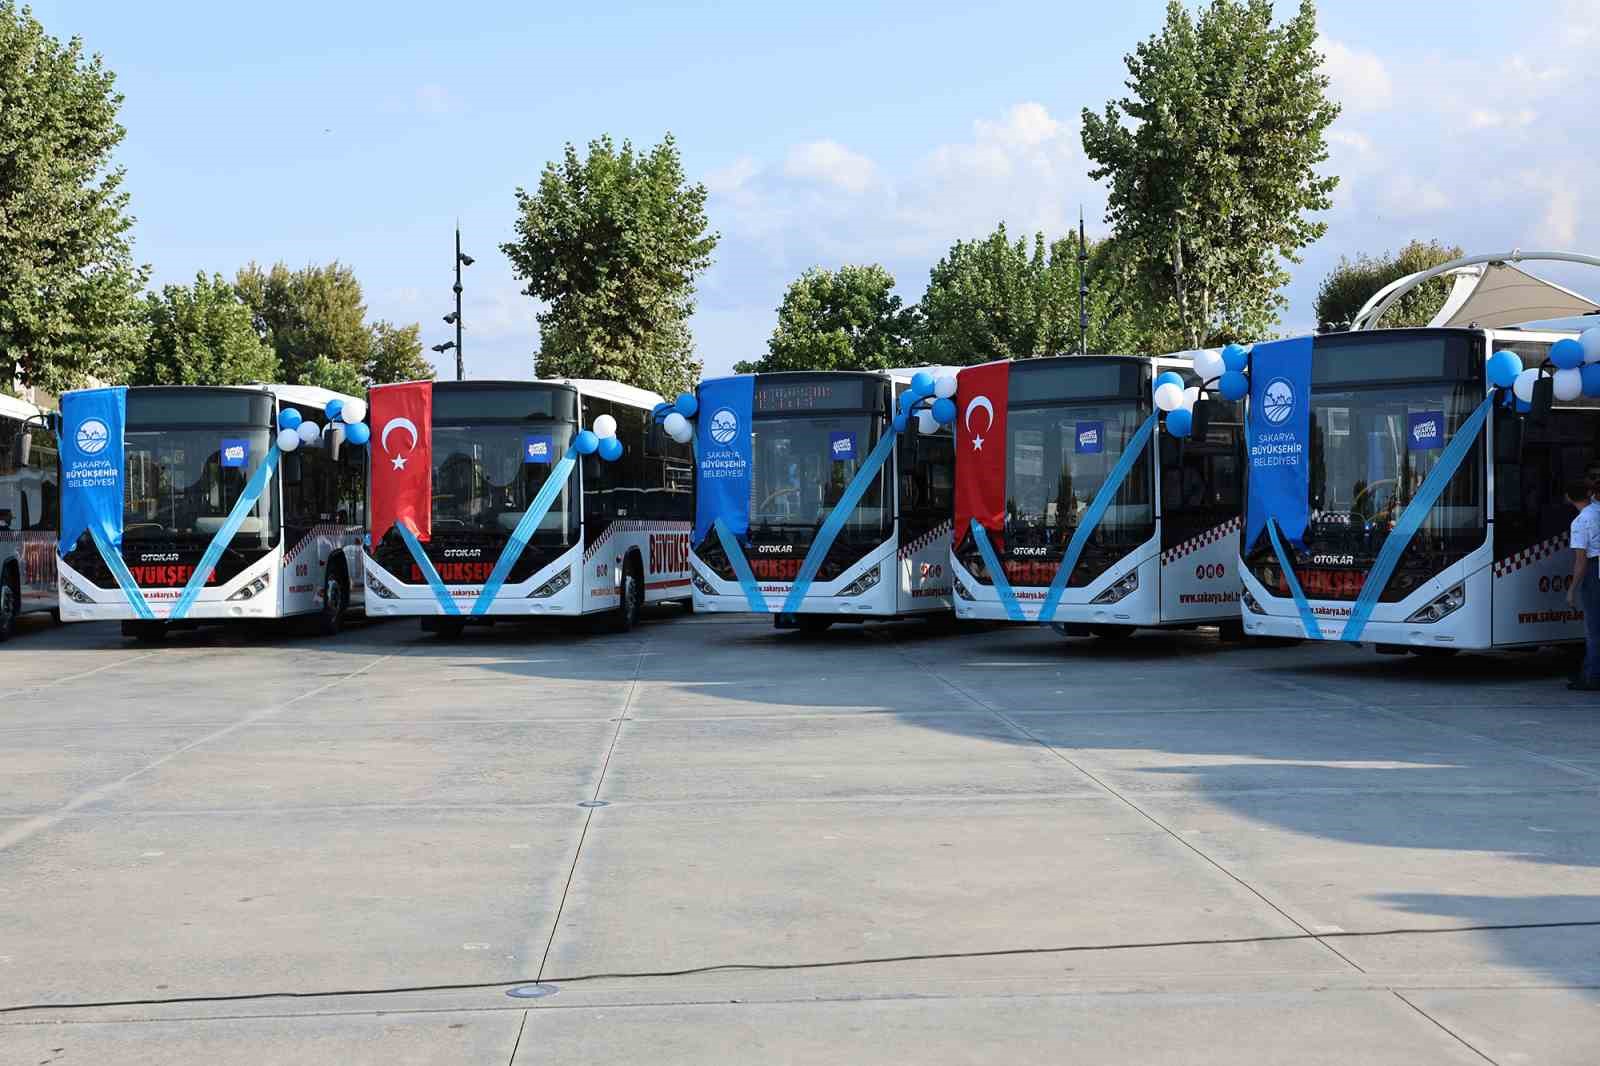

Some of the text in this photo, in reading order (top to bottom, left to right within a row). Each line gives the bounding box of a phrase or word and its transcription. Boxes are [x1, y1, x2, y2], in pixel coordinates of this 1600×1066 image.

[1258, 433, 1296, 443] SAKARYA
[1251, 443, 1302, 455] BÜYÜKŞEHİR
[706, 451, 740, 460] SAKARYA
[72, 460, 112, 469] SAKARYA
[701, 459, 747, 469] BÜYÜKŞEHİR
[1253, 455, 1299, 467] BELEDİYESİ
[66, 468, 118, 479] BÜYÜKŞEHİR
[703, 469, 743, 478] BELEDİYESİ
[68, 478, 115, 488] BELEDİYESİ
[444, 549, 481, 557] OTOKAR
[758, 544, 793, 553] OTOKAR
[1013, 547, 1047, 556] OTOKAR
[141, 553, 179, 562] OTOKAR
[650, 533, 688, 578] BÜYÜKŞE
[1313, 555, 1354, 565] OTOKAR
